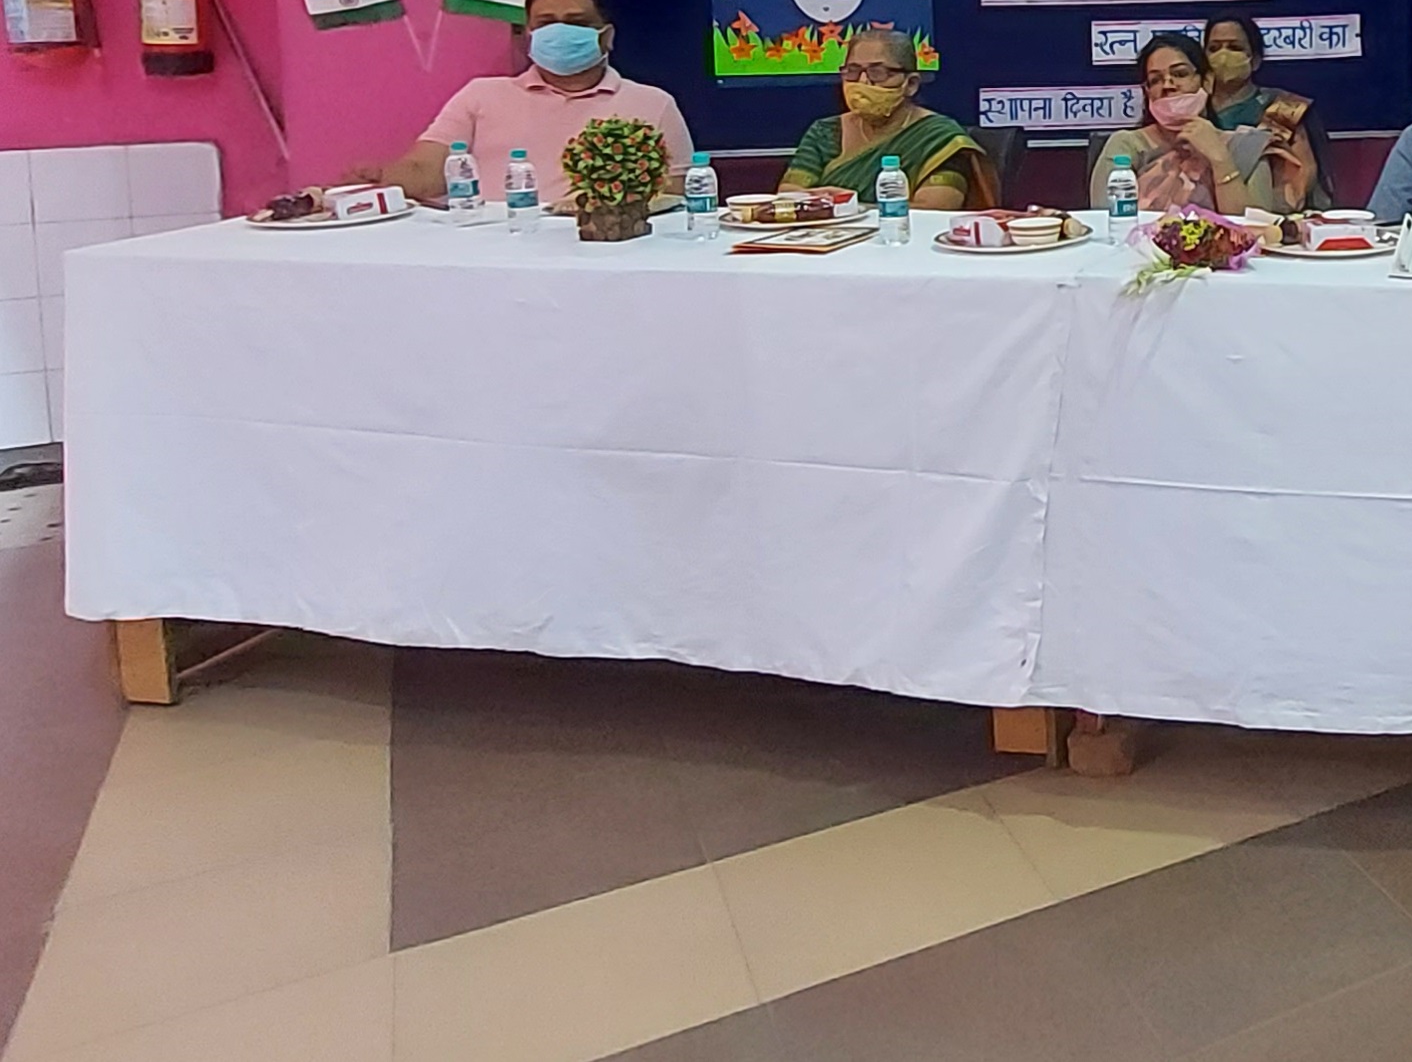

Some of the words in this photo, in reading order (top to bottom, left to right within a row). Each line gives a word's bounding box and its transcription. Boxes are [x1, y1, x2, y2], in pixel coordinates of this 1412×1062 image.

[1097, 29, 1139, 55] रत्न
[1260, 20, 1313, 50] टरबरी
[1319, 24, 1349, 50] का
[980, 97, 1052, 123] स्थापना
[1121, 89, 1136, 118] है
